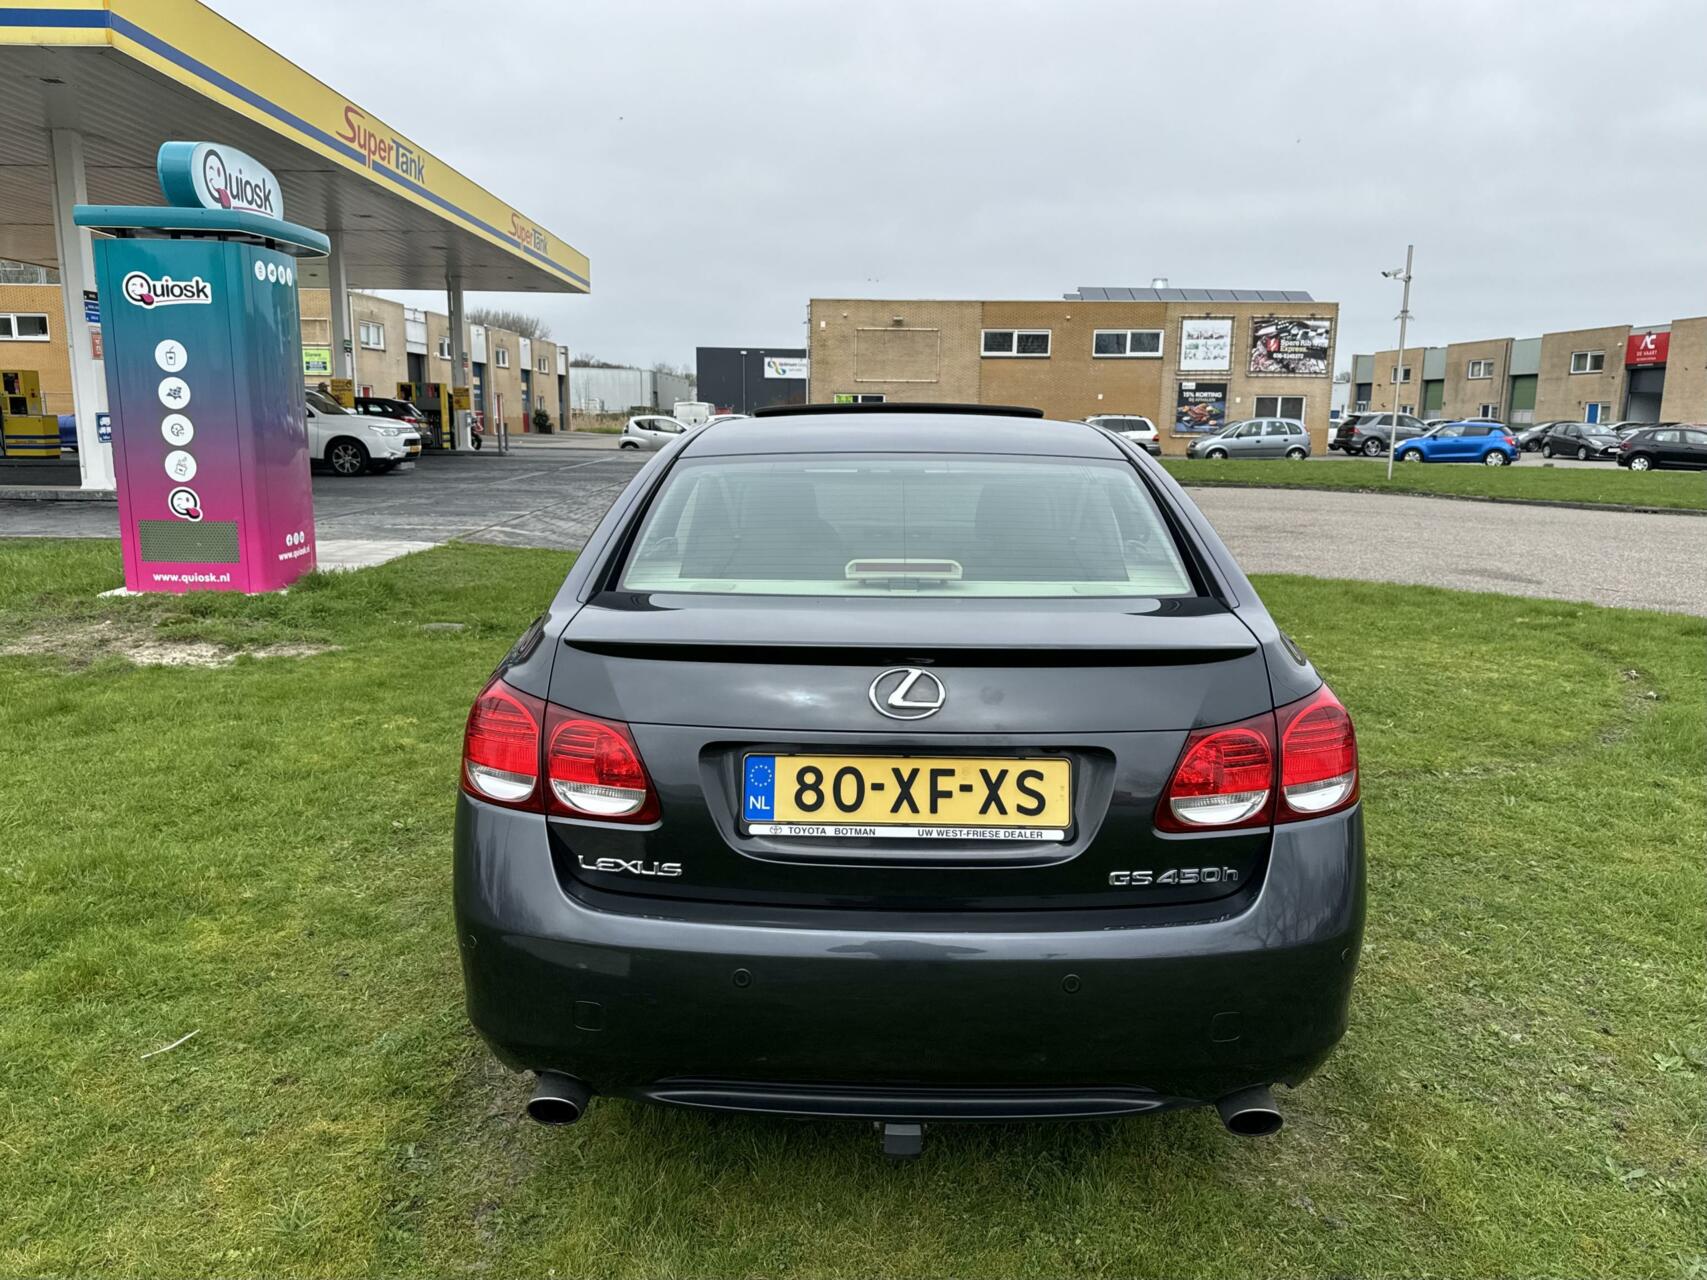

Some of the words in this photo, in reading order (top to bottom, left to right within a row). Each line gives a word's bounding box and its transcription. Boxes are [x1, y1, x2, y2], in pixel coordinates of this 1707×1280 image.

[335, 105, 425, 184] SuperTank
[203, 149, 273, 213] Quiosk
[125, 274, 209, 305] Quiosk
[152, 572, 231, 584] www.quiosk.nl
[794, 765, 1046, 816] 80-XF-XS
[749, 795, 771, 810] NL
[788, 827, 826, 835] TOYOTA
[834, 828, 876, 836] BOTMAN
[917, 829, 934, 837] UW
[936, 829, 1001, 838] WEST-FRIESE
[1003, 830, 1043, 839] DEALER
[577, 855, 682, 876] LEXUS
[1108, 870, 1153, 885] GS
[1156, 866, 1239, 885] 450h
